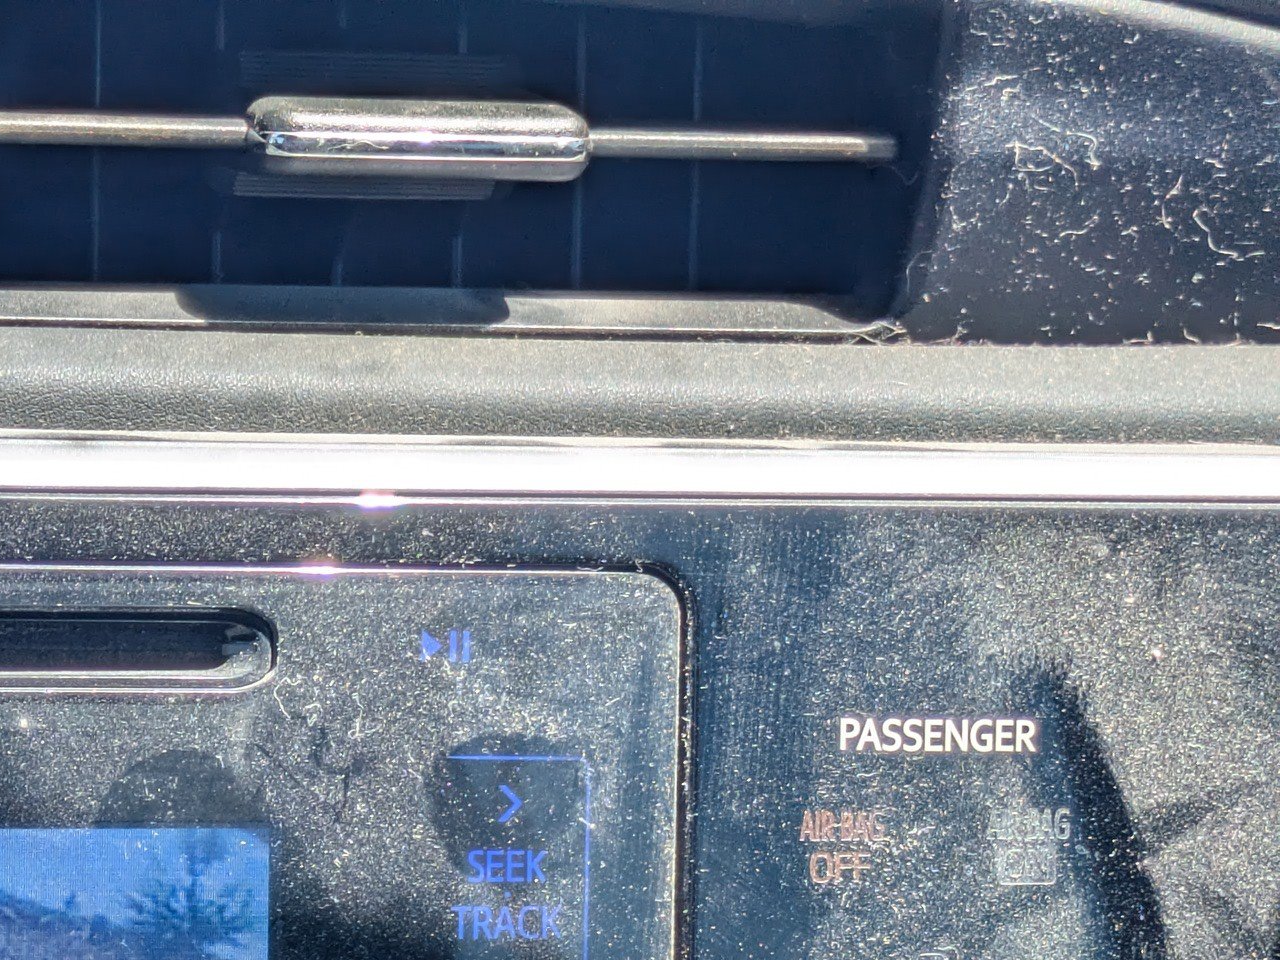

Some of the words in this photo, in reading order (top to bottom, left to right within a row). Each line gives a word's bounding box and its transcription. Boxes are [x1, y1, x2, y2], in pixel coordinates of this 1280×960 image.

[838, 717, 1037, 752] PASSENGER
[467, 849, 548, 883] SEEK
[809, 850, 872, 886] OFF
[450, 904, 563, 941] TRACK
